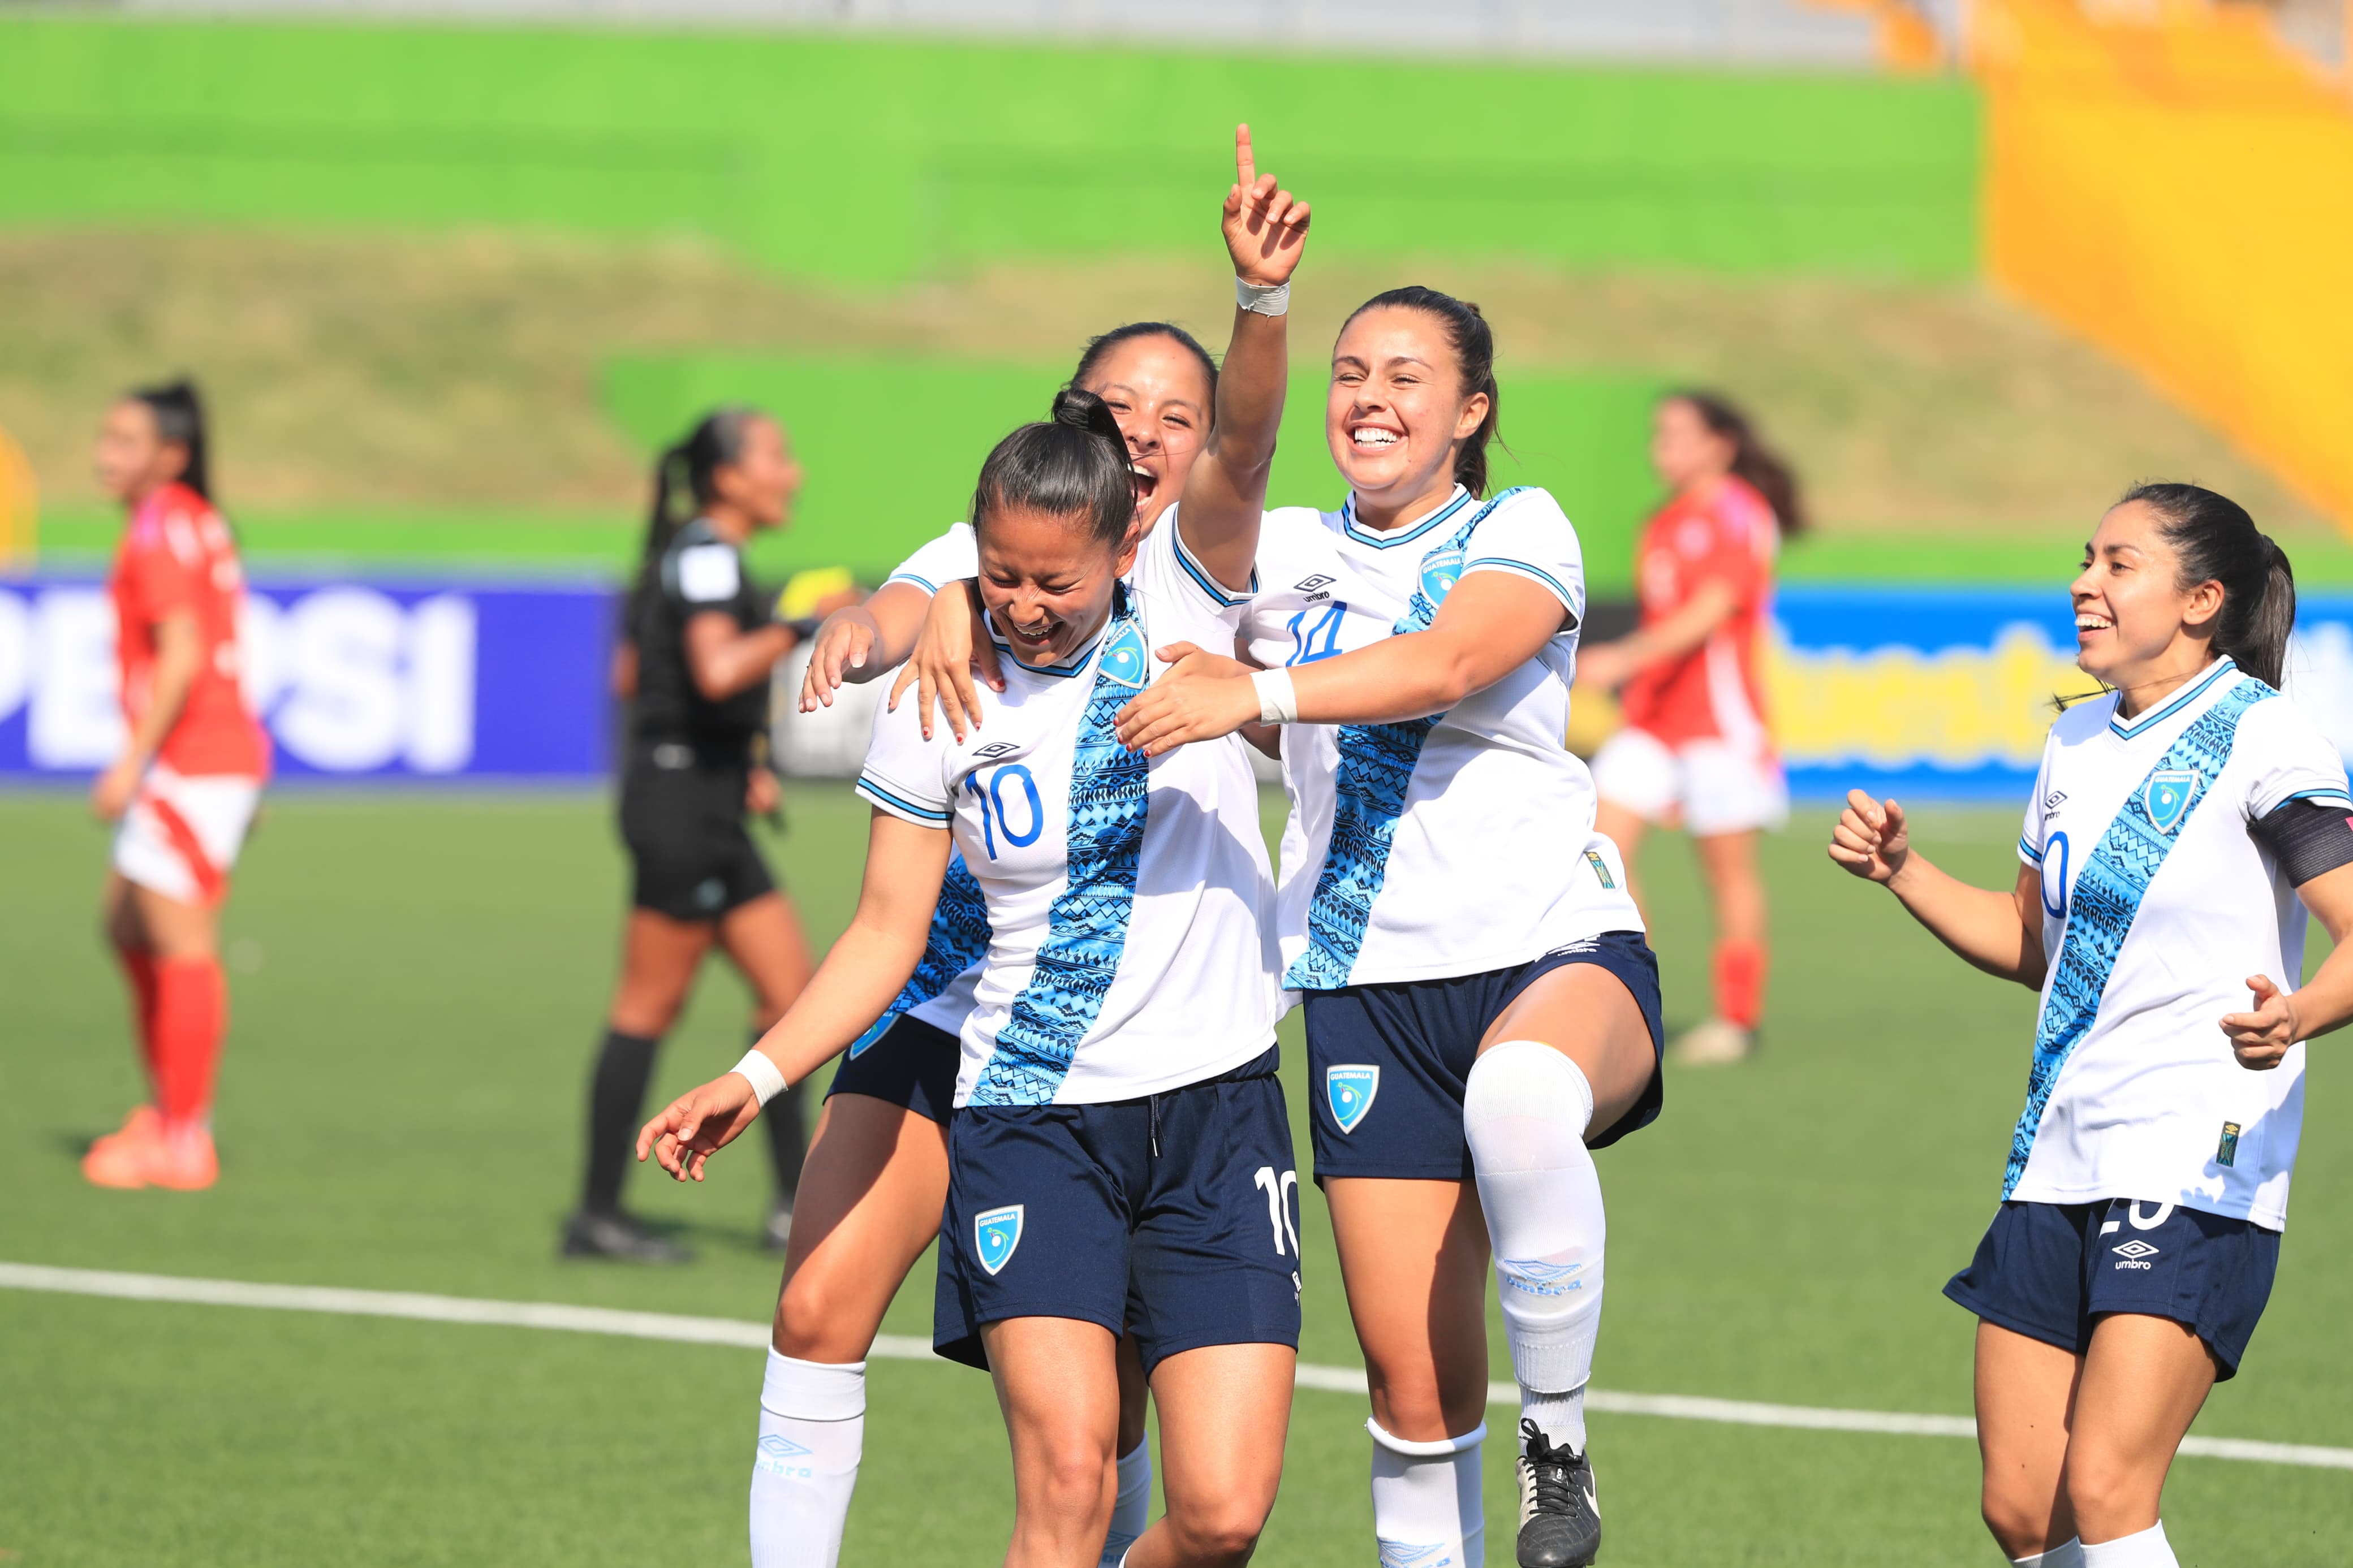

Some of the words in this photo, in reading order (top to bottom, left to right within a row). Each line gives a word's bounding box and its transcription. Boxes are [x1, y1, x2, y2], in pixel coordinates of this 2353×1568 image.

[1303, 591, 1330, 602] umbro
[1286, 601, 1347, 667] 14
[0, 585, 476, 772] ESI
[965, 764, 1044, 860] 10
[1330, 1072, 1372, 1081] GUATEMALA
[979, 1213, 1016, 1228] GUATEMALA
[2115, 1258, 2152, 1270] umbro
